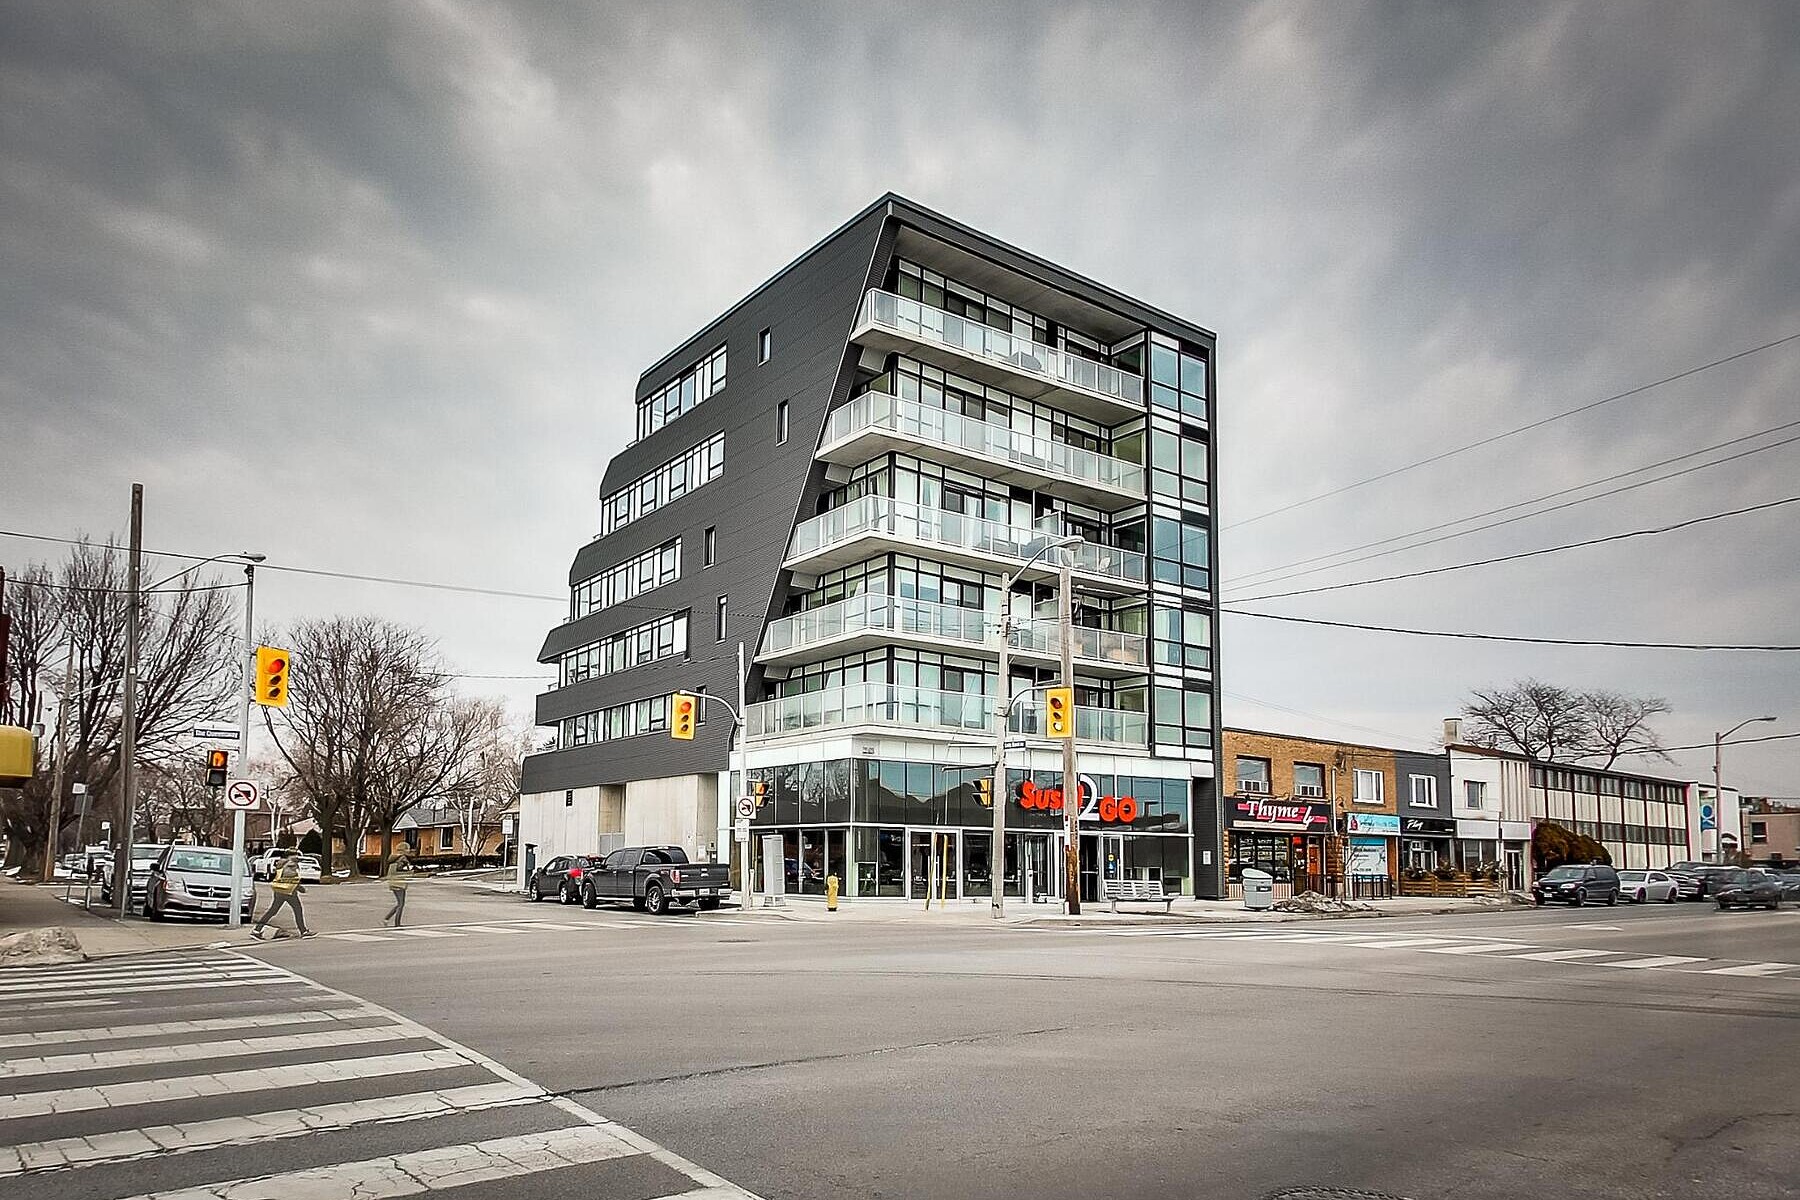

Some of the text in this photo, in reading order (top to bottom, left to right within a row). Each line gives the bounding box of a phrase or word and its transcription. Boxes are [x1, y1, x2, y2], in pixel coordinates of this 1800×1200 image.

[1079, 773, 1100, 821] 2
[1100, 795, 1138, 823] GO
[1246, 798, 1299, 823] Thyme
